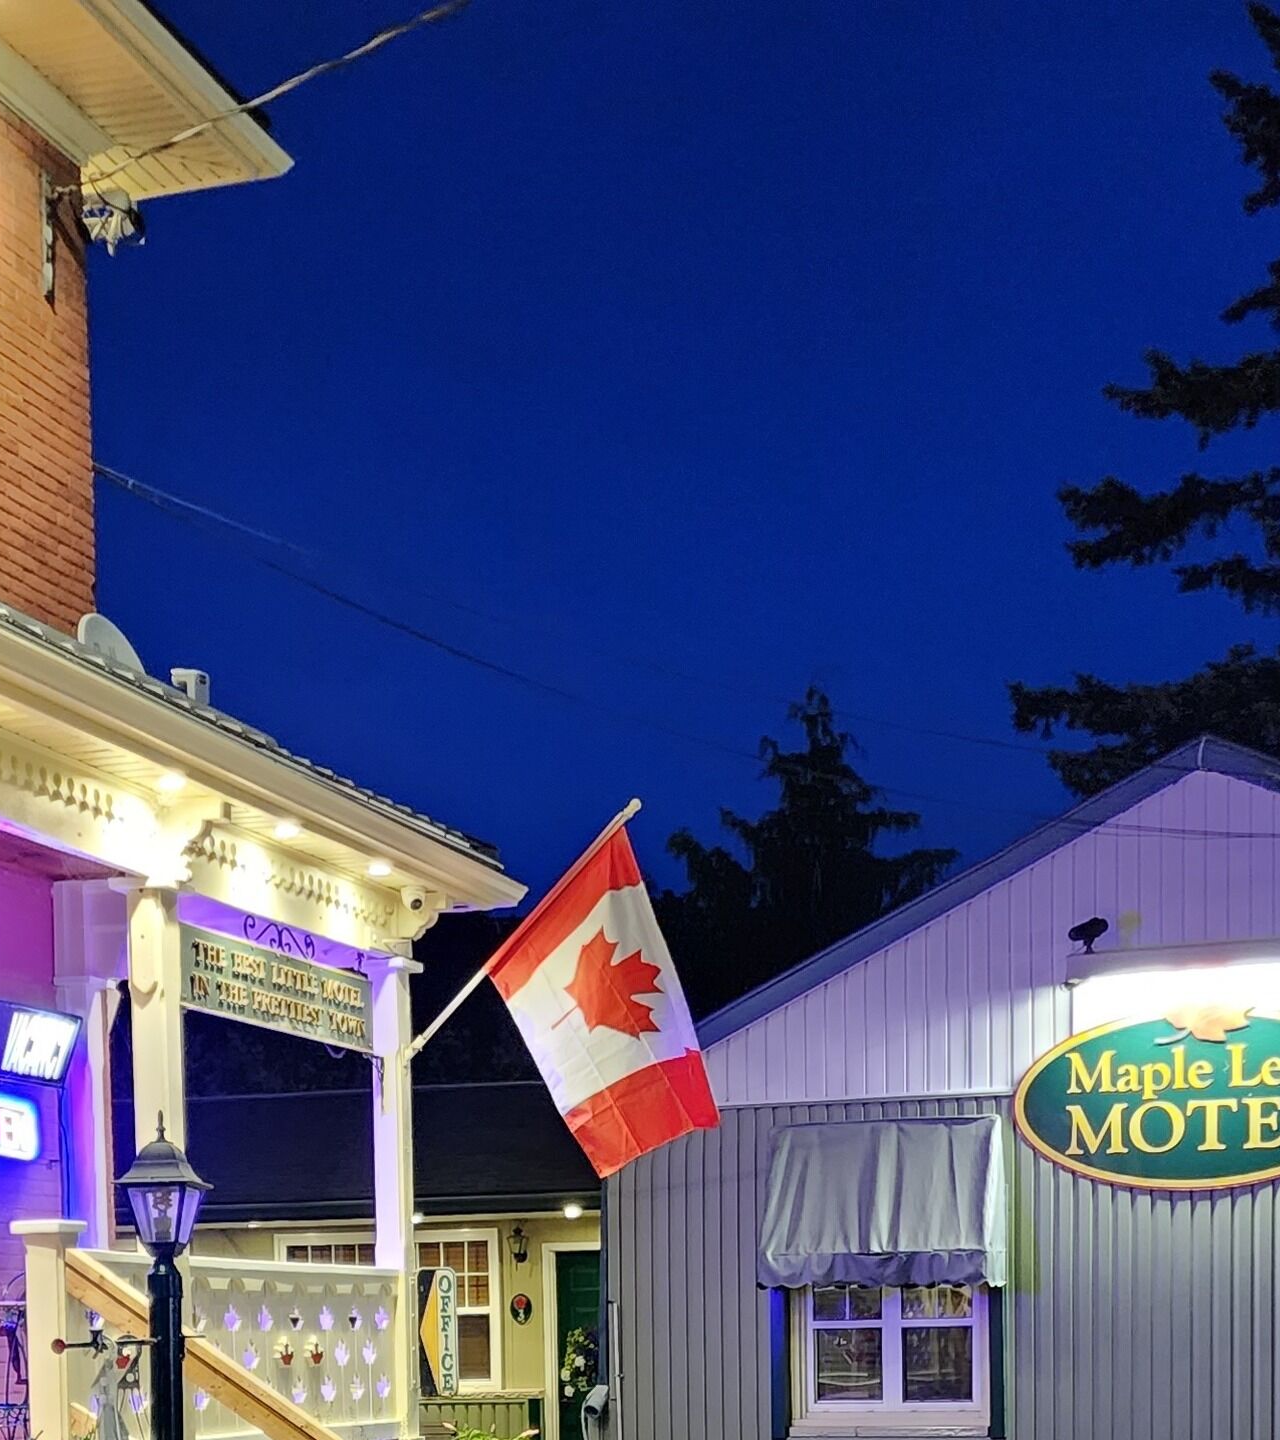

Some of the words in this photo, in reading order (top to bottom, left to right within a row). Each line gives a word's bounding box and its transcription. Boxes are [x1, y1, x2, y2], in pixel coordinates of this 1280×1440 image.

[191, 974, 211, 997] IN
[217, 979, 250, 1008] THE
[251, 991, 324, 1023] PRETTIEST
[329, 1013, 365, 1039] TOWN
[193, 938, 227, 968] THE
[232, 953, 266, 978] BEST
[271, 963, 317, 995] LITTLE
[322, 978, 365, 1008] MOTEL
[1065, 1045, 1214, 1100] Maple
[438, 1275, 455, 1392] OFFICE
